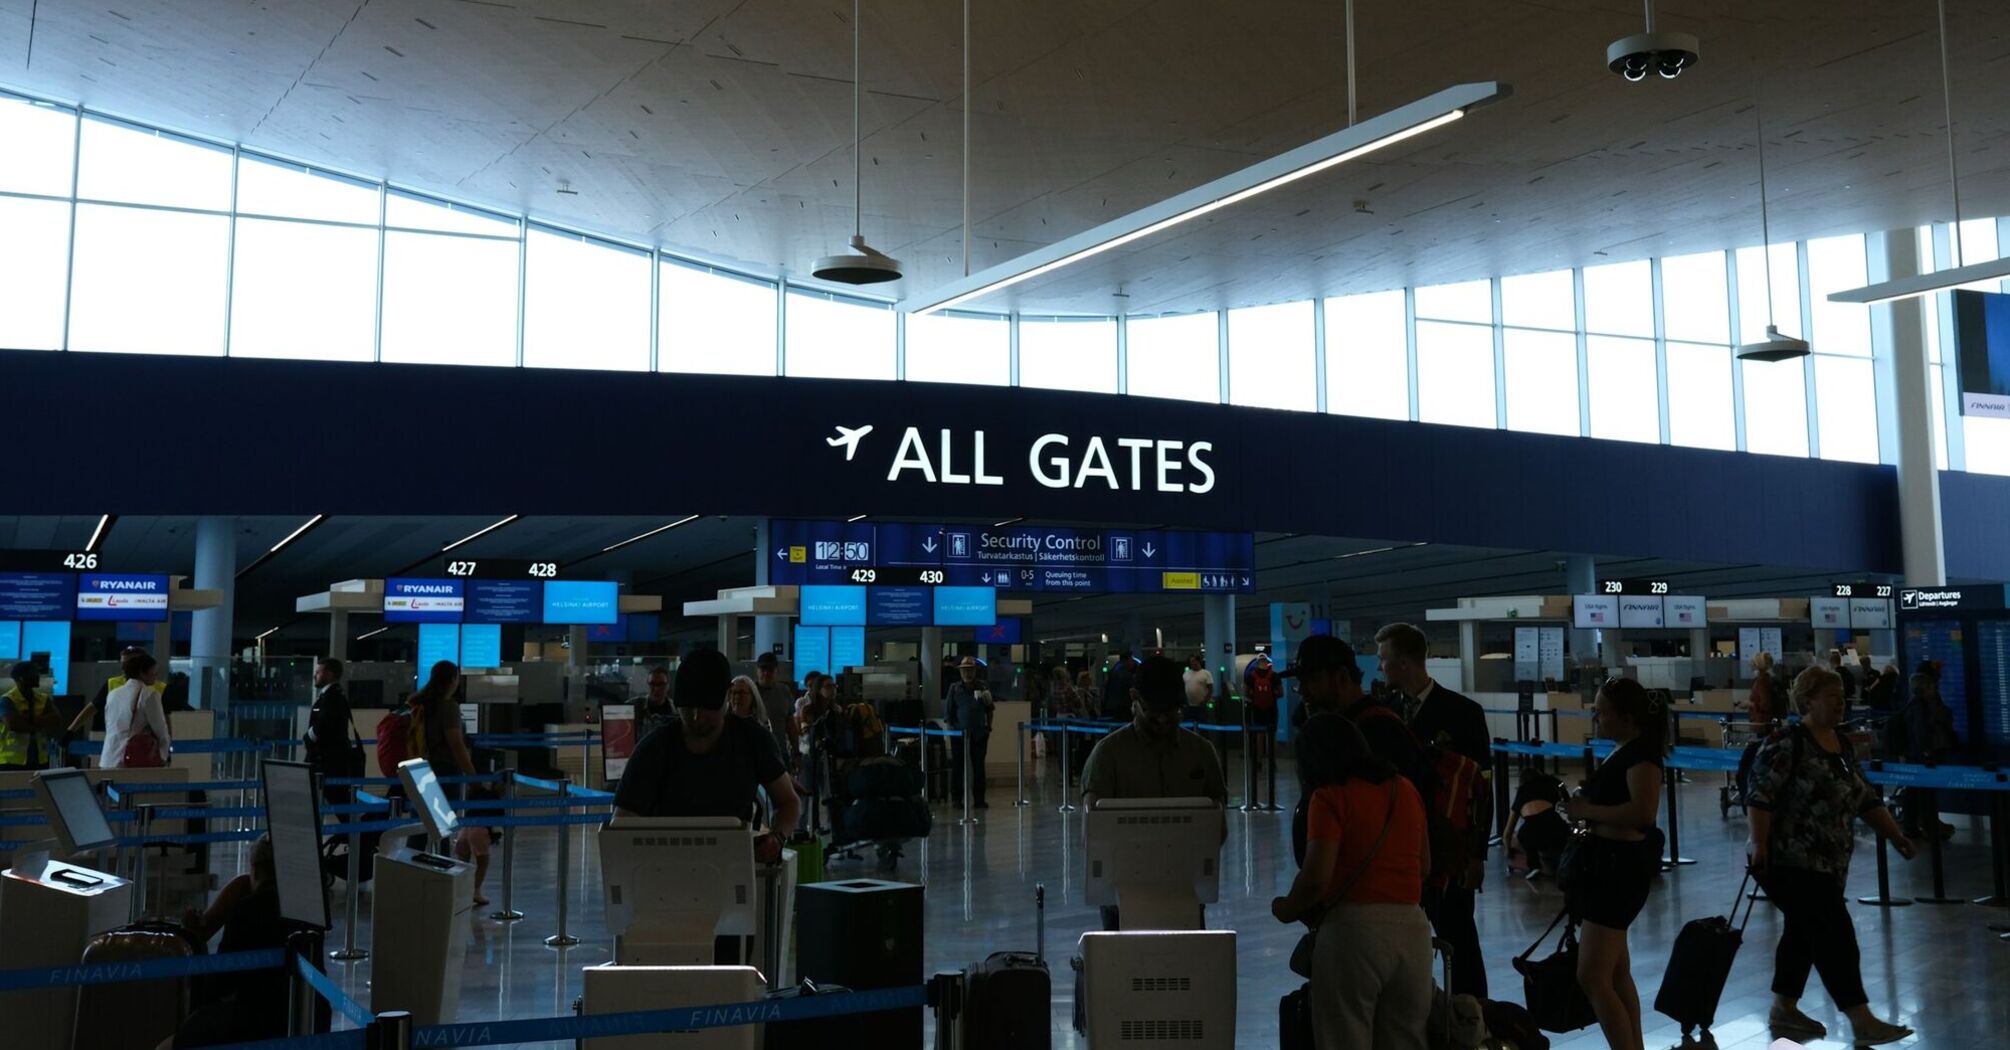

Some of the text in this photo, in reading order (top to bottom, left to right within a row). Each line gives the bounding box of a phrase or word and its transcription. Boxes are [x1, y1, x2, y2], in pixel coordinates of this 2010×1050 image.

[1971, 401, 2005, 411] FINNAIR
[886, 426, 1216, 494] ALL GATES
[980, 532, 1100, 552] Security Control
[816, 541, 869, 560] 12:50
[977, 551, 1034, 560] Turvatarkastus
[1039, 551, 1105, 561] Säkerhetskontroll
[64, 553, 97, 569] 426
[447, 561, 476, 576] 427
[528, 562, 557, 577] 428
[851, 569, 876, 583] 429
[920, 570, 944, 584] 430
[1020, 570, 1034, 580] 0-5
[1045, 571, 1087, 580] Queuing time
[100, 580, 156, 590] RYANAIR
[403, 584, 454, 594] RYANAIR
[1074, 580, 1091, 588] point
[1605, 581, 1622, 593] 230
[1651, 582, 1668, 593] 229
[1836, 585, 1851, 597] 228
[1876, 585, 1890, 597] 227
[1918, 591, 1961, 602] Departures
[49, 964, 143, 985] FINAVIA
[689, 1004, 781, 1025] FINAVIA
[415, 1026, 492, 1046] NAVIA
